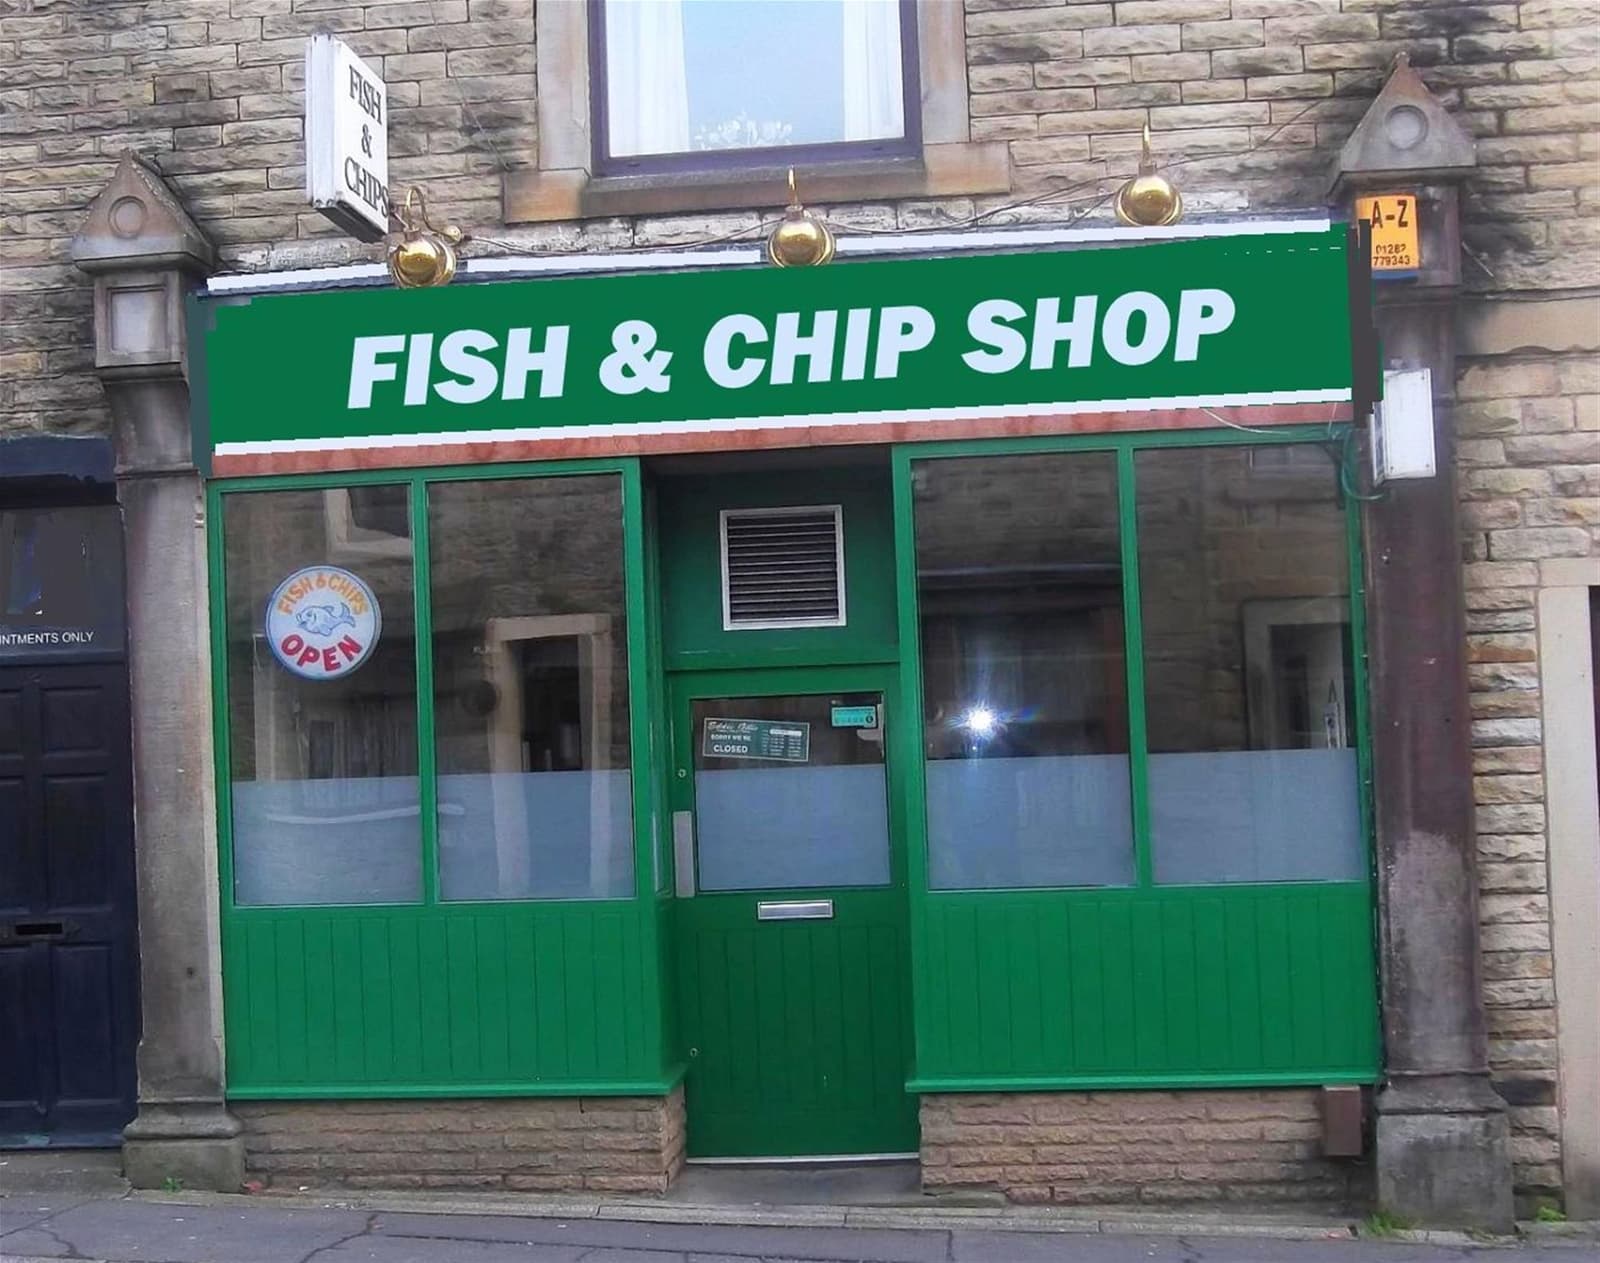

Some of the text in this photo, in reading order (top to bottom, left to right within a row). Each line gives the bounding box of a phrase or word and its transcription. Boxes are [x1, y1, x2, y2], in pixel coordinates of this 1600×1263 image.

[349, 64, 382, 125] FISH
[361, 123, 372, 159] &
[344, 156, 390, 218] CHIPS
[1371, 200, 1409, 229] A-Z
[349, 289, 1236, 409] FISH & CHIP SHOP
[277, 576, 314, 615] FISH
[328, 574, 368, 615] CHIPS
[61, 631, 94, 643] ONLY
[281, 634, 363, 672] OPEN
[713, 744, 748, 753] CLOSED
